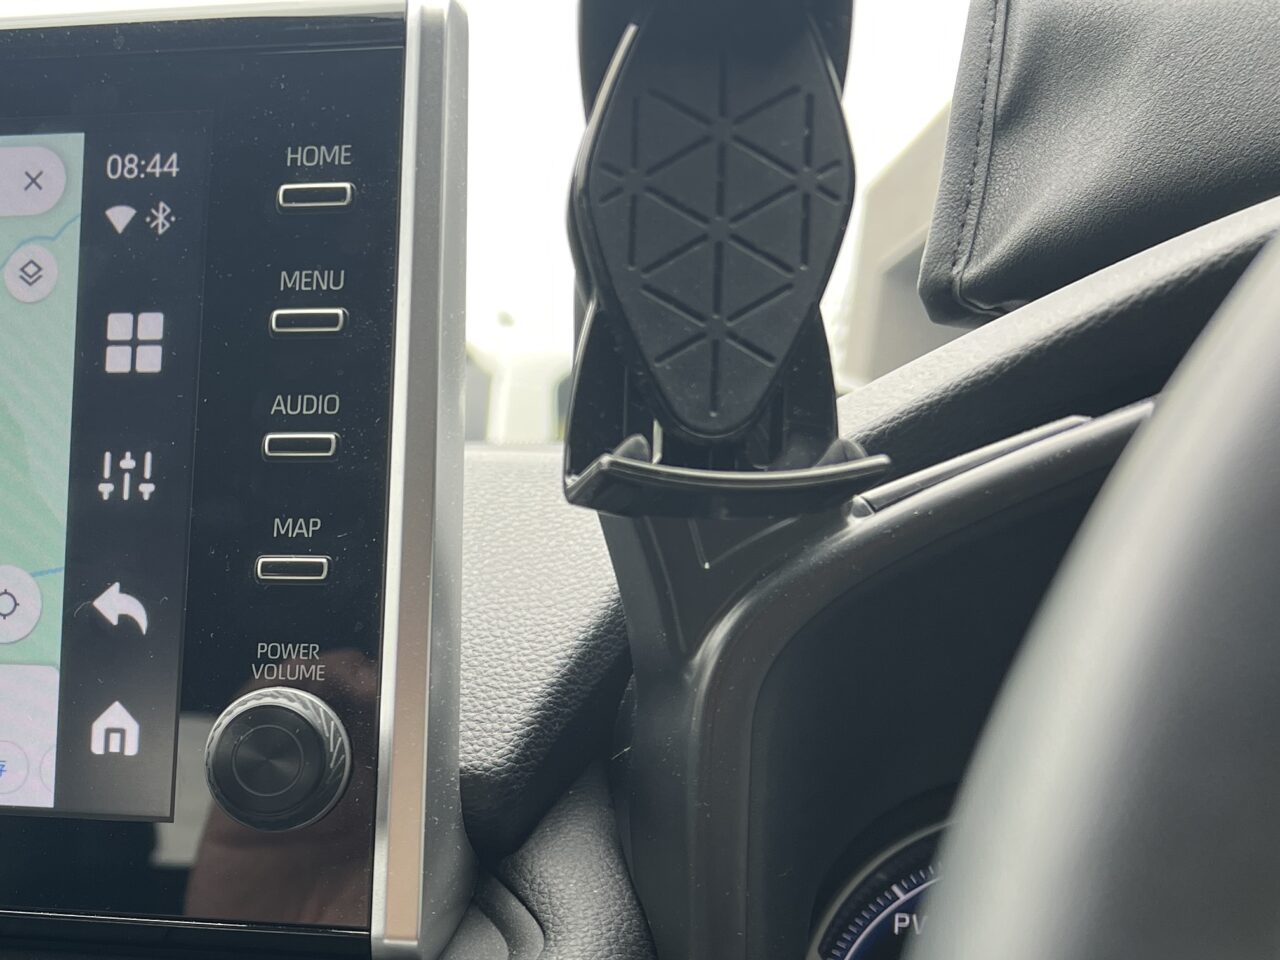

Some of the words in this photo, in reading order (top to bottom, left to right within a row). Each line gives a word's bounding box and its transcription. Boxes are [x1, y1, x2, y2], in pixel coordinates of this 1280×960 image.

[105, 152, 180, 180] 08:44
[286, 144, 353, 167] HOME
[280, 269, 346, 291] MENU
[270, 394, 341, 415] AUDIO
[273, 517, 322, 538] MAP
[256, 641, 320, 660] POWER
[251, 663, 326, 681] VOLUME
